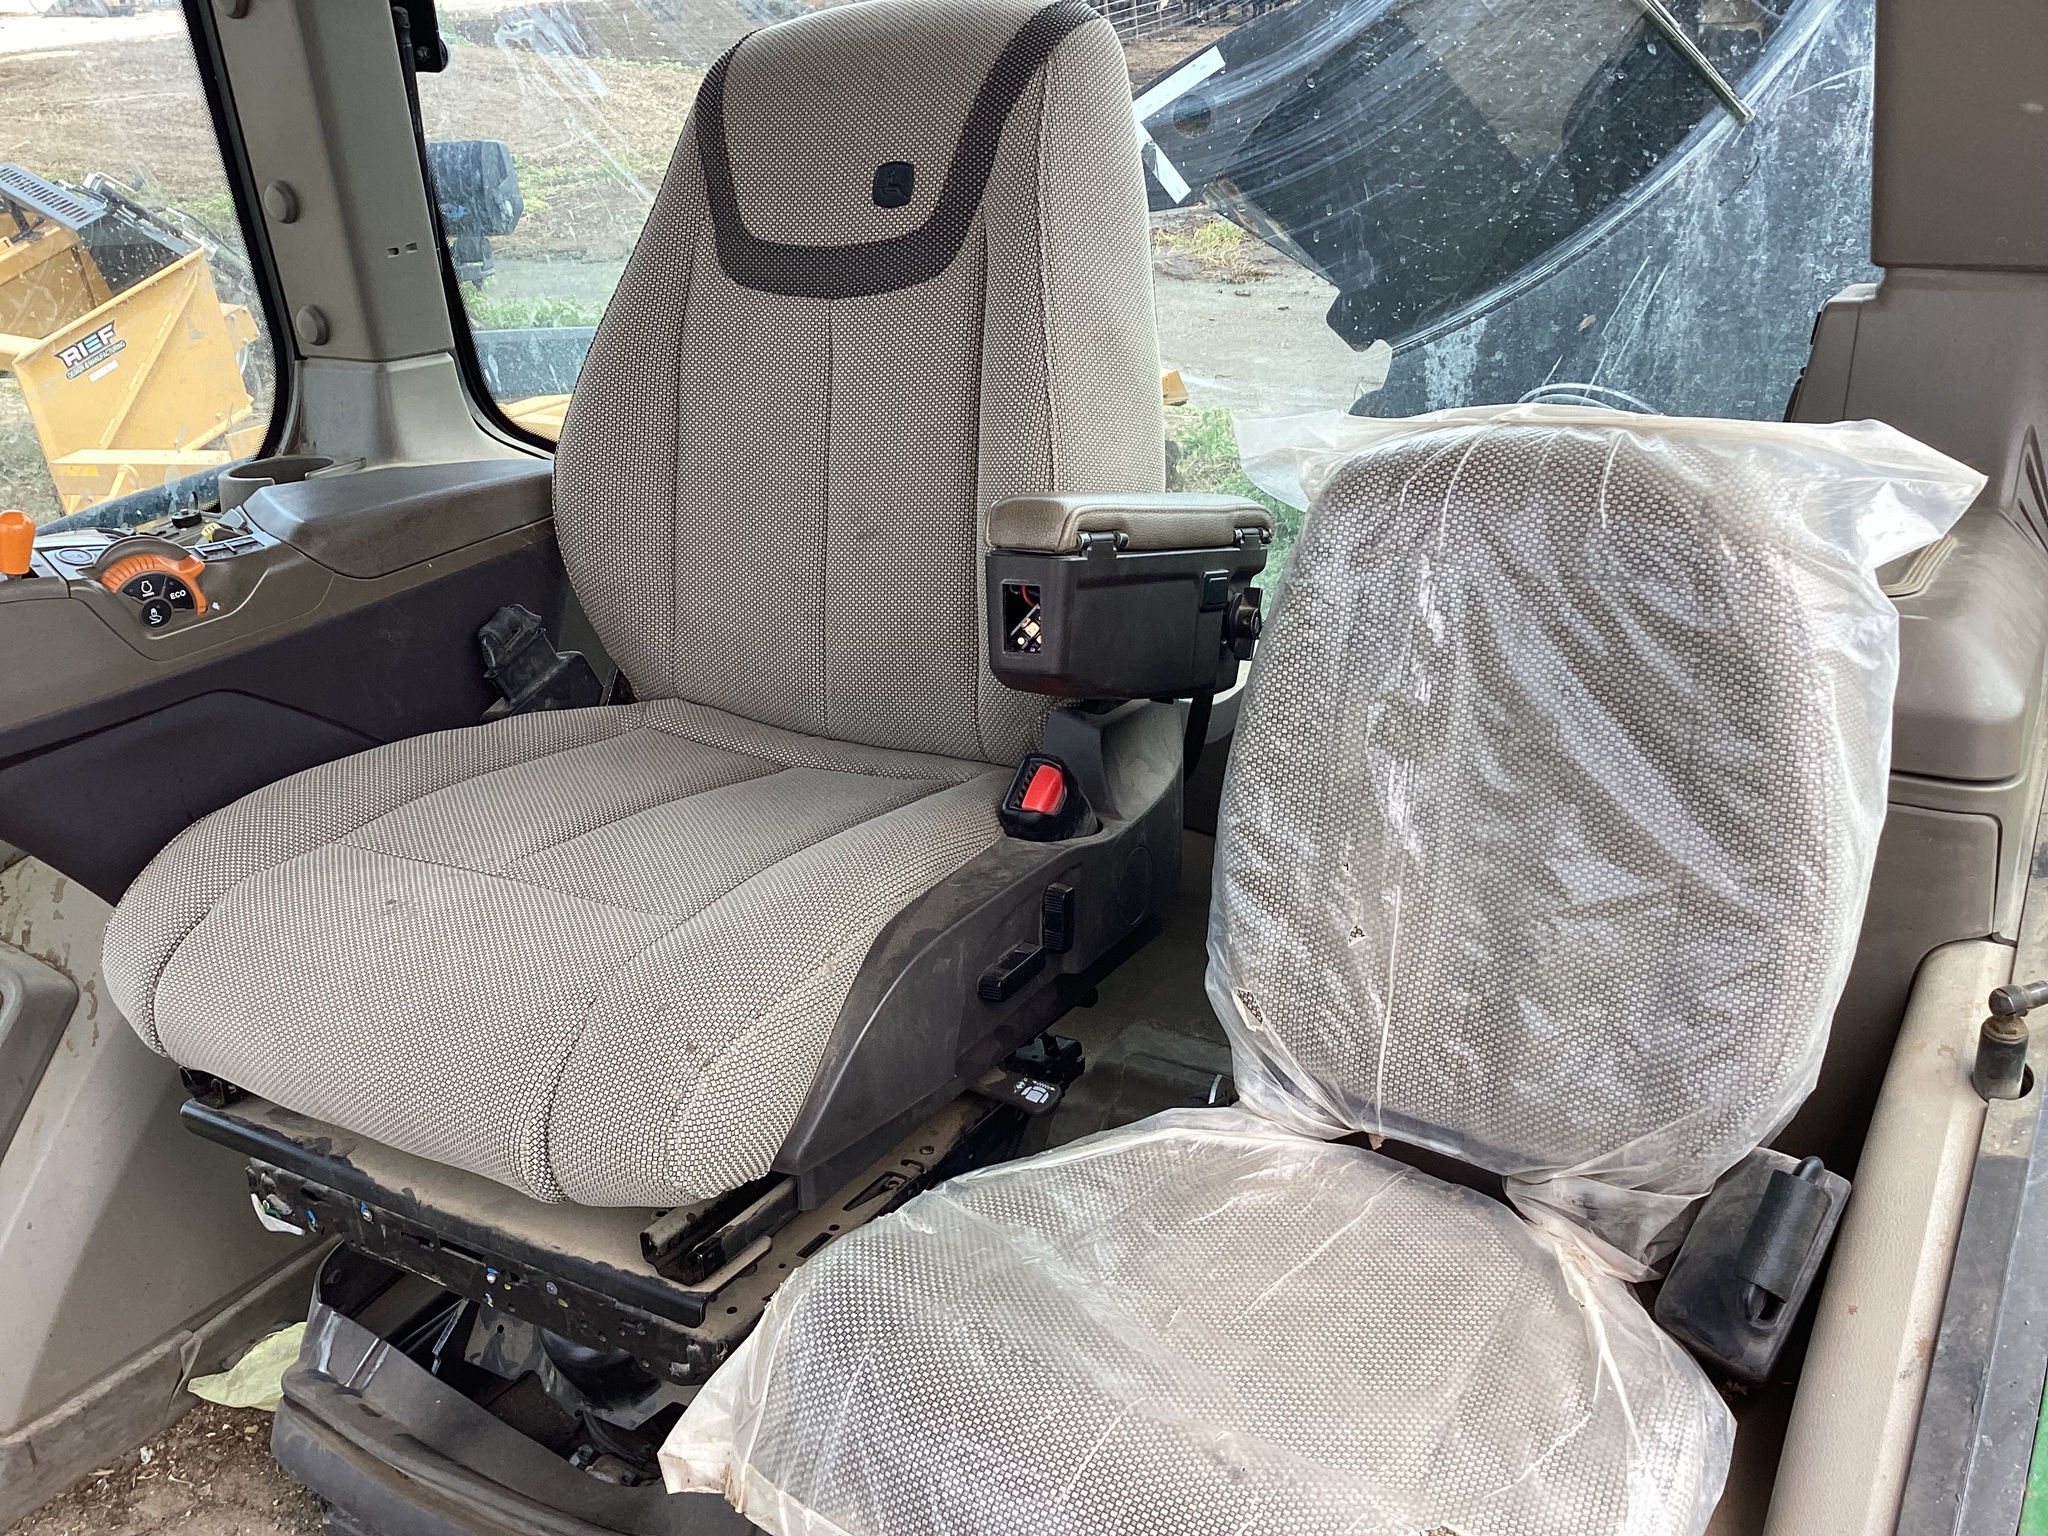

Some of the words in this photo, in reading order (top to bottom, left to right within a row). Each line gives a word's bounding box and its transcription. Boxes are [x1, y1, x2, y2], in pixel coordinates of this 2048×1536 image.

[58, 324, 115, 367] RIEF
[87, 341, 126, 366] MANUFACTURING
[170, 590, 186, 599] ECO
